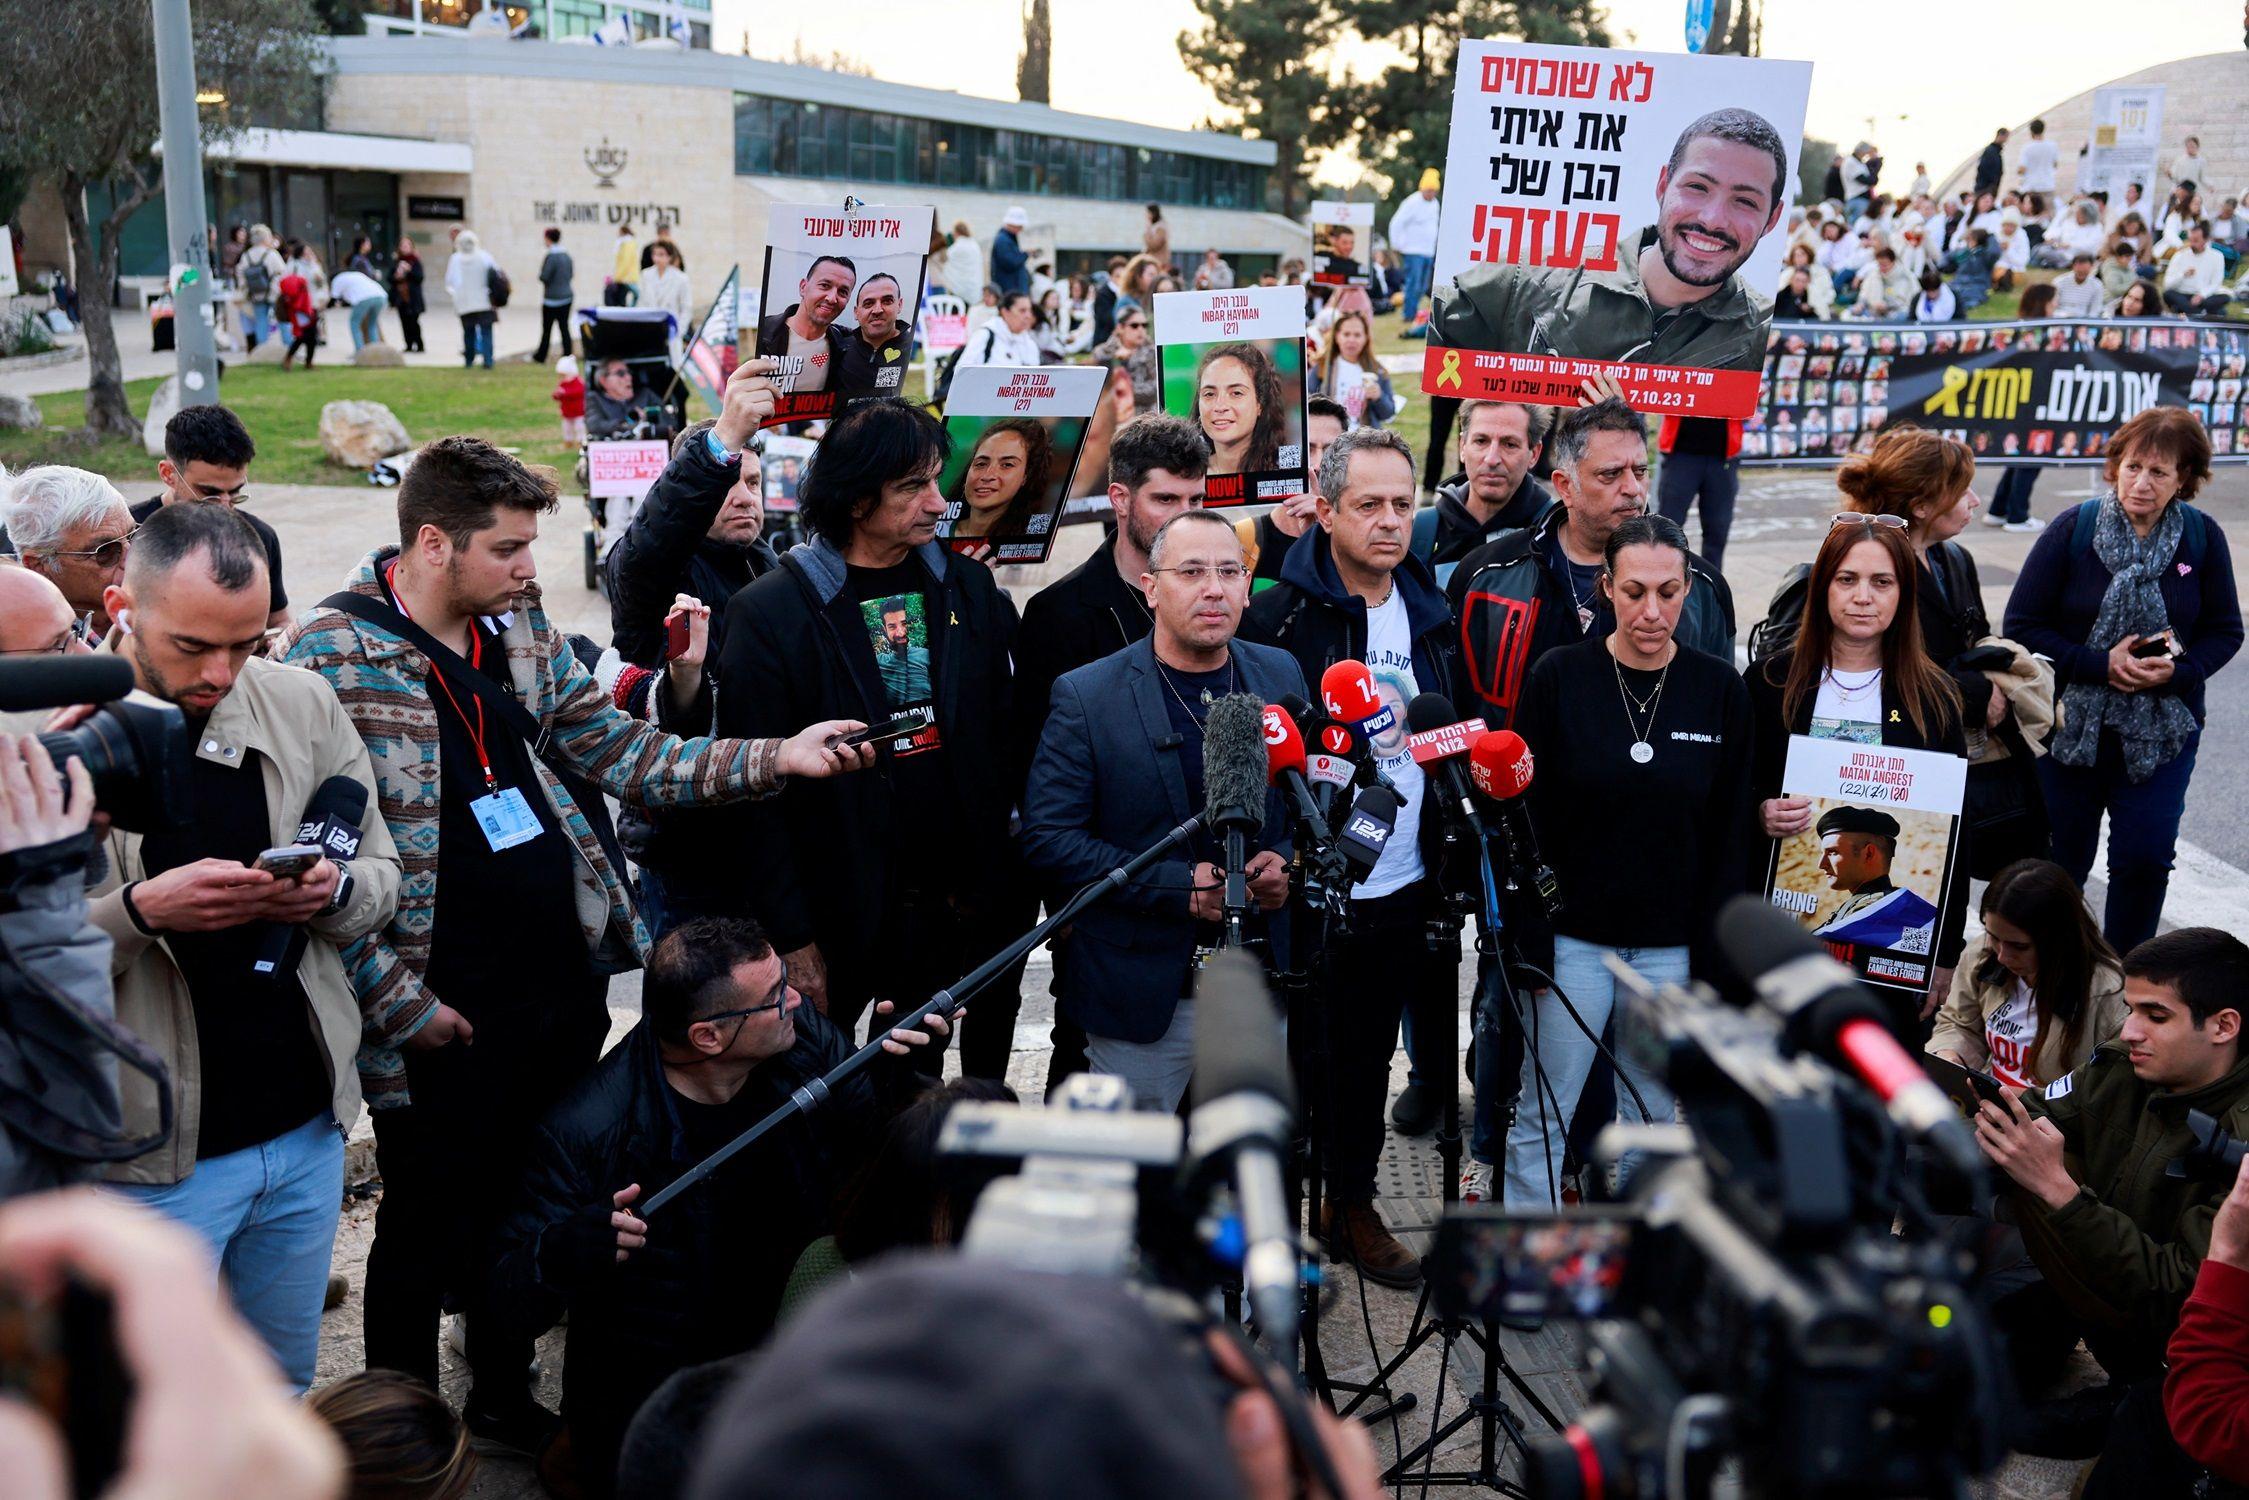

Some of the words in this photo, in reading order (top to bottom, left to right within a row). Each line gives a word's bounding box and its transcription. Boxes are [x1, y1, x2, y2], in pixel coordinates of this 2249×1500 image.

[1480, 55, 1601, 99] שוכחים
[1609, 61, 1655, 103] לא
[1490, 106, 1564, 148] איתי
[1573, 112, 1627, 152] את
[1489, 153, 1552, 197] שלי
[1562, 162, 1621, 205] הבן
[534, 201, 556, 222] THE
[562, 202, 600, 223] JOINT
[804, 217, 845, 238] שרעבי
[880, 218, 901, 239] אלי
[1469, 204, 1621, 272] בעזה!
[1211, 296, 1229, 310] הימן
[1231, 295, 1249, 307] ענבר
[1201, 309, 1225, 322] INBAR
[1227, 308, 1260, 321] HAYMAN
[1223, 321, 1239, 336] (27)
[1474, 354, 1505, 369] לעזה
[1509, 357, 1545, 373] ונחטף
[1549, 360, 1568, 374] עוז
[1011, 374, 1031, 387] הימן
[1031, 374, 1050, 386] ענבר
[1633, 367, 1648, 382] חן
[1653, 368, 1680, 383] איתי
[997, 386, 1021, 398] INBAR
[1021, 386, 1056, 399] HAYMAN
[1482, 377, 1507, 392] לעד
[1511, 379, 1542, 395] שלנו
[1545, 383, 1588, 399] אריות
[1963, 367, 2034, 419] יחד!
[2034, 364, 2117, 422] כולם.
[1013, 399, 1031, 412] (27)
[1629, 390, 1682, 406] 7.10.23
[2121, 371, 2162, 422] את
[1207, 474, 1245, 498] NOW!
[1257, 486, 1283, 498] FAMILIES
[1283, 484, 1303, 496] FORUM
[996, 550, 1022, 559] FAMILIES
[1022, 549, 1042, 558] FORUM
[1356, 674, 1380, 704] 14
[1362, 710, 1393, 734] עכשיו
[1331, 729, 1345, 751] y
[1409, 722, 1467, 748] החדשות
[1436, 736, 1468, 755] N12
[1852, 752, 1886, 770] אנגרסט
[1888, 757, 1905, 772] מתן
[1839, 765, 1871, 781] MATAN
[1872, 772, 1914, 787] ANGREST
[1350, 817, 1387, 843] i24
[325, 826, 359, 857] i24
[1771, 887, 1818, 915] BRING
[1867, 962, 1899, 977] FAMILIES
[1899, 968, 1925, 982] FORUM
[1893, 960, 1905, 969] AND
